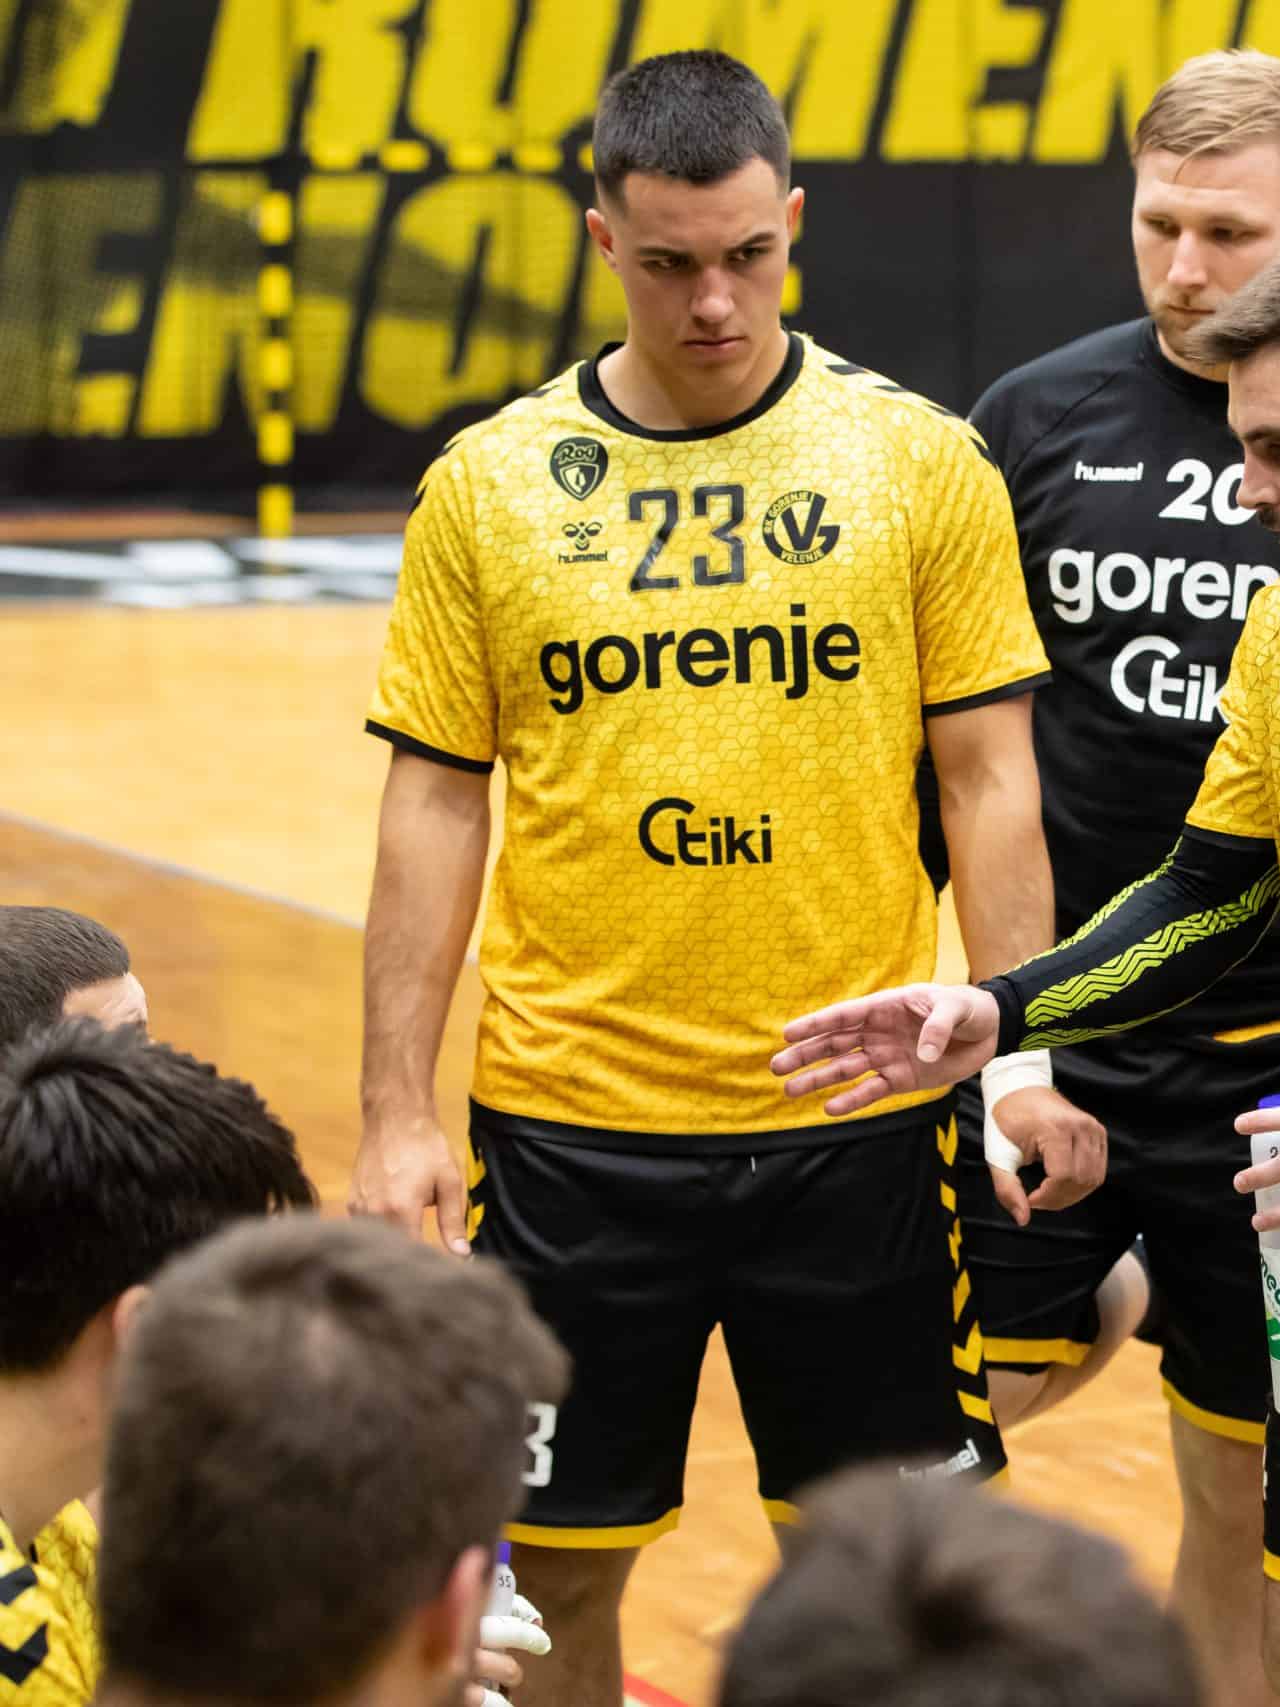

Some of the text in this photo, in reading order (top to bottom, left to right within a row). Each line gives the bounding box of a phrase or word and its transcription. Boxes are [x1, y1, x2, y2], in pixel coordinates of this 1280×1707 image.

[1074, 460, 1144, 481] hummel
[768, 491, 809, 519] GORENJE
[629, 484, 746, 592] 23
[558, 551, 608, 564] hummel
[780, 548, 824, 565] VELENJE
[539, 603, 861, 715] gorenje
